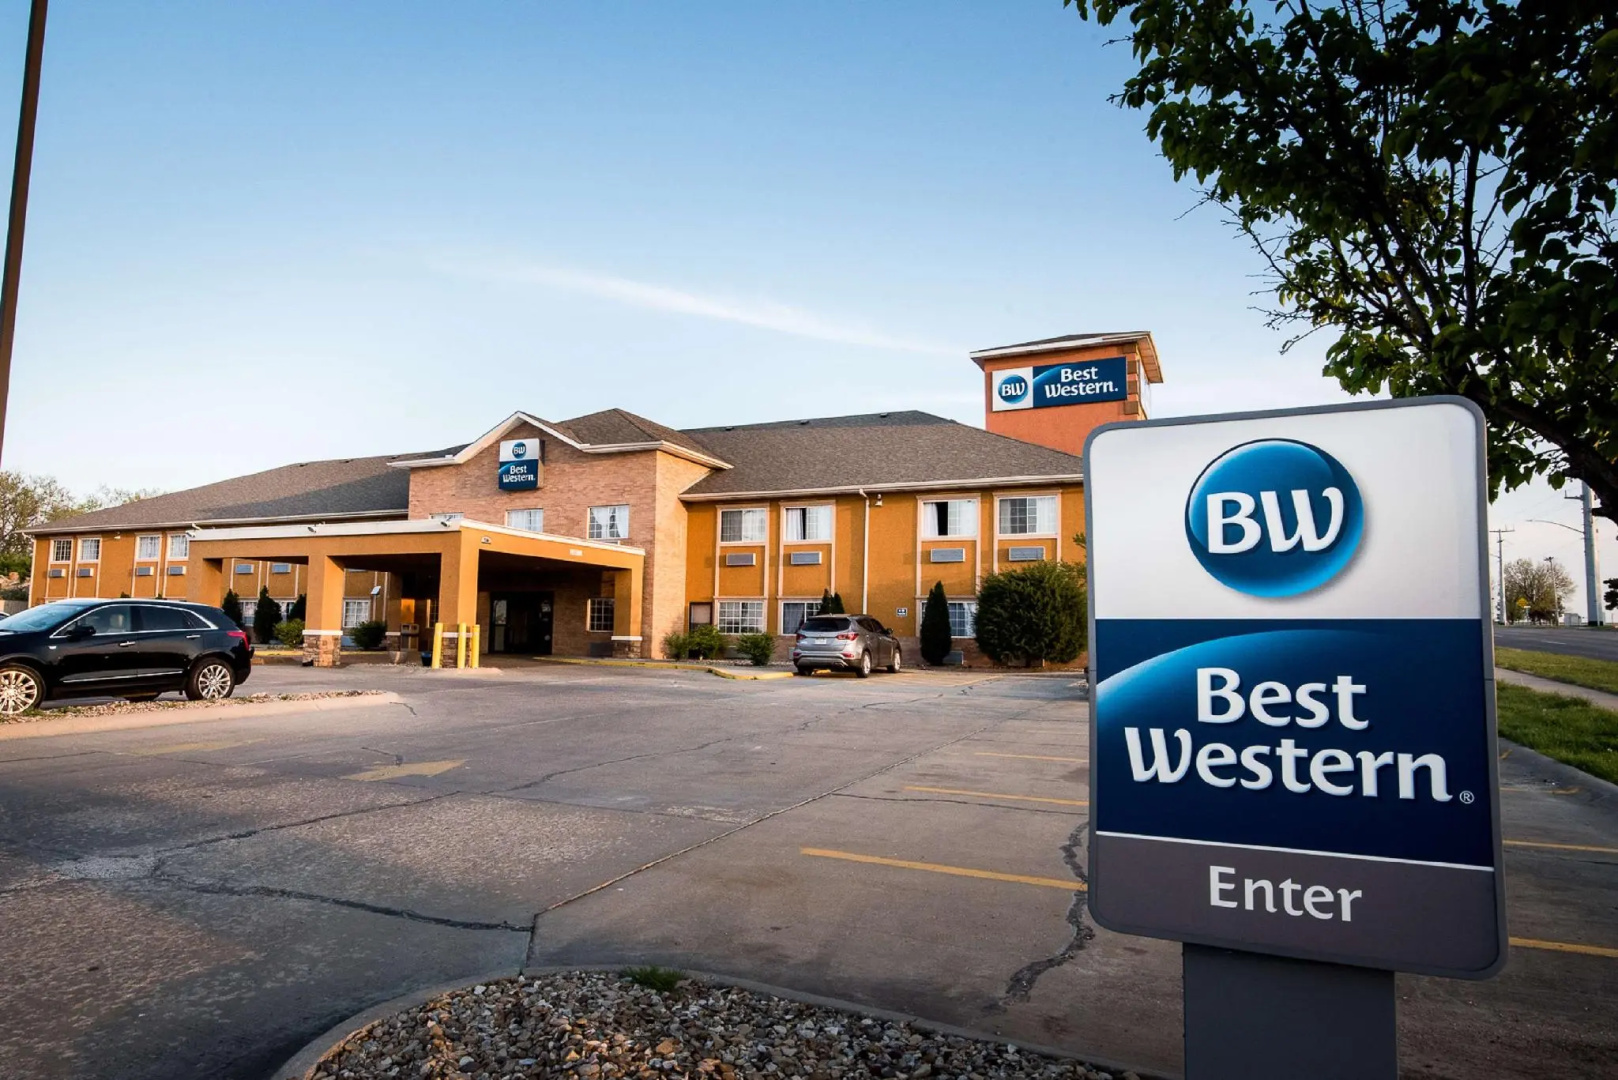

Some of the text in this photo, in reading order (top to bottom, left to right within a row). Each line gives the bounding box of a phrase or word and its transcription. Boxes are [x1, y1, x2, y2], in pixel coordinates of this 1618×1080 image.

[1061, 366, 1098, 382] Best
[1002, 382, 1025, 396] BW
[513, 446, 525, 454] BW
[510, 465, 527, 474] Best
[1206, 486, 1344, 554] BW
[1196, 667, 1369, 730] Best
[1208, 865, 1362, 922] Enter
